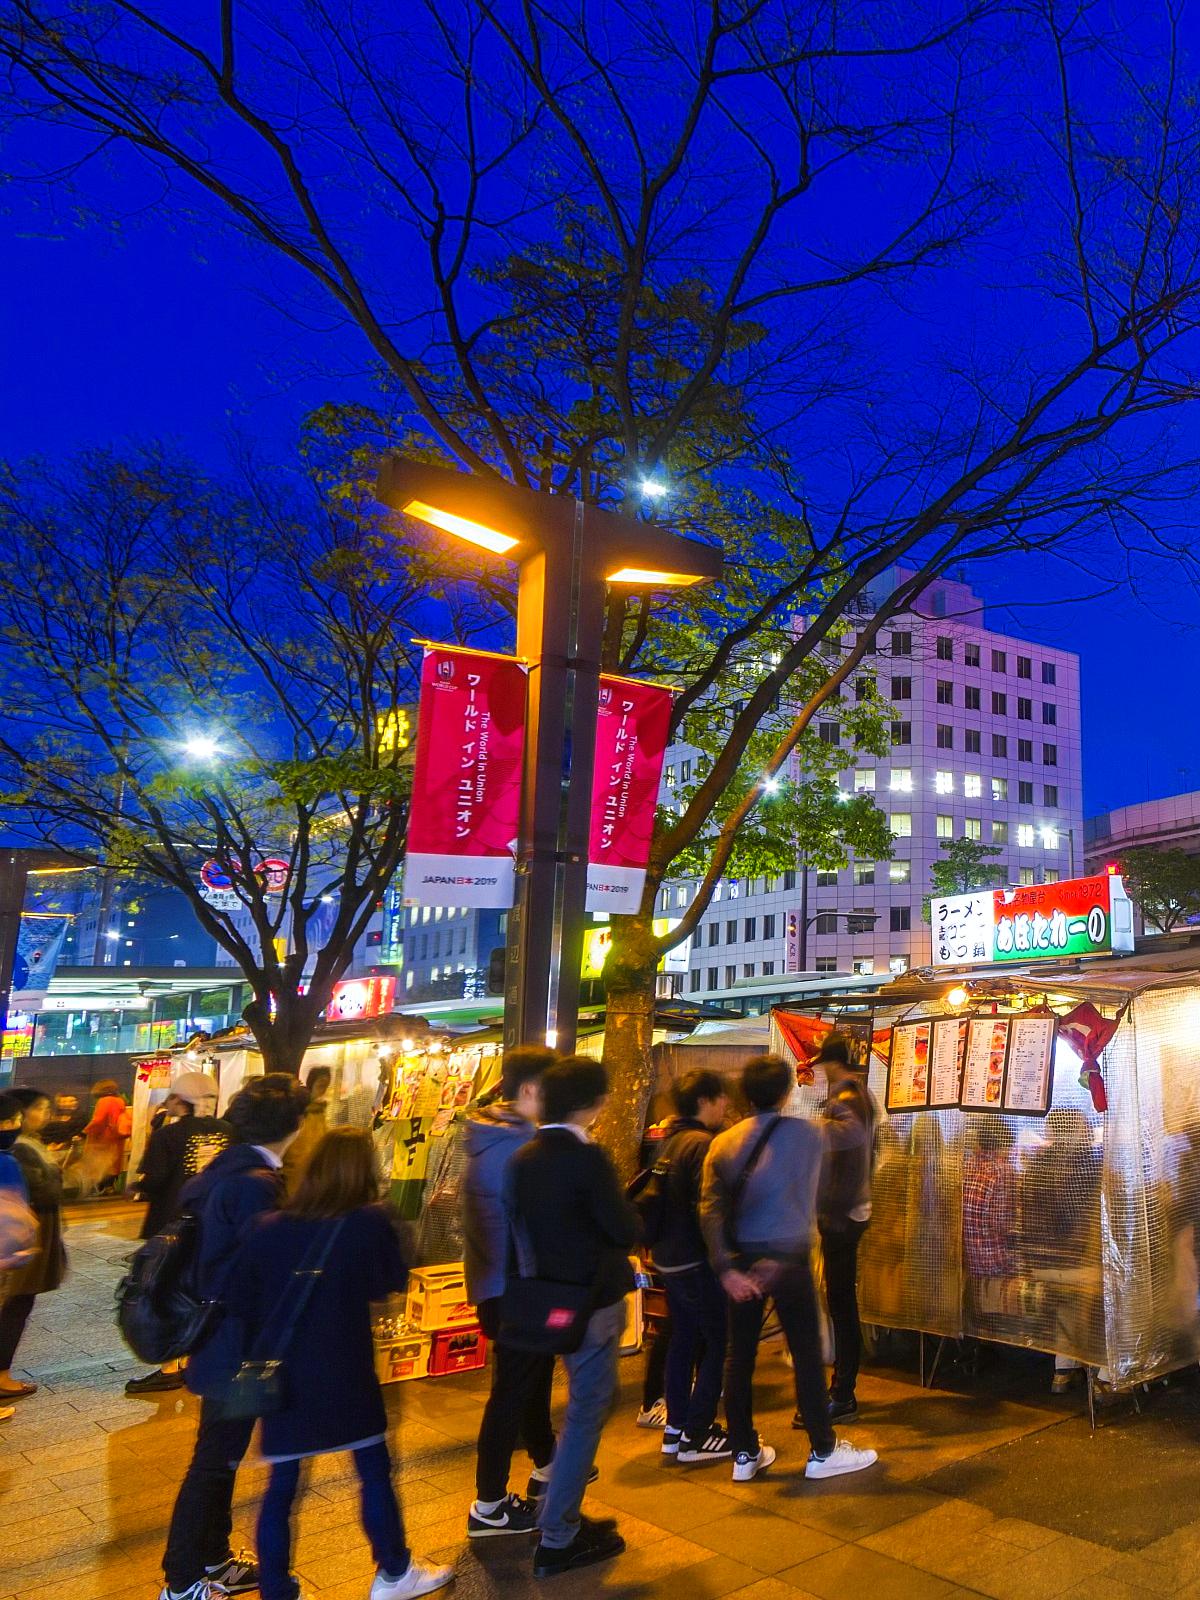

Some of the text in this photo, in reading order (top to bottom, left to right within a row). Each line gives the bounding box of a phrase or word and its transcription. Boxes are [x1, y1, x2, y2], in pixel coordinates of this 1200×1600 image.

[480, 711, 491, 729] The
[456, 673, 481, 838] ワールド イン ユニオン
[478, 731, 489, 760] World
[628, 735, 638, 751] The
[600, 700, 634, 849] ワールド イン ユニオン
[624, 752, 636, 780] World
[475, 774, 486, 803] Union
[618, 792, 629, 818] Union
[586, 882, 629, 894] PAN日本2019
[1080, 882, 1102, 898] 1972
